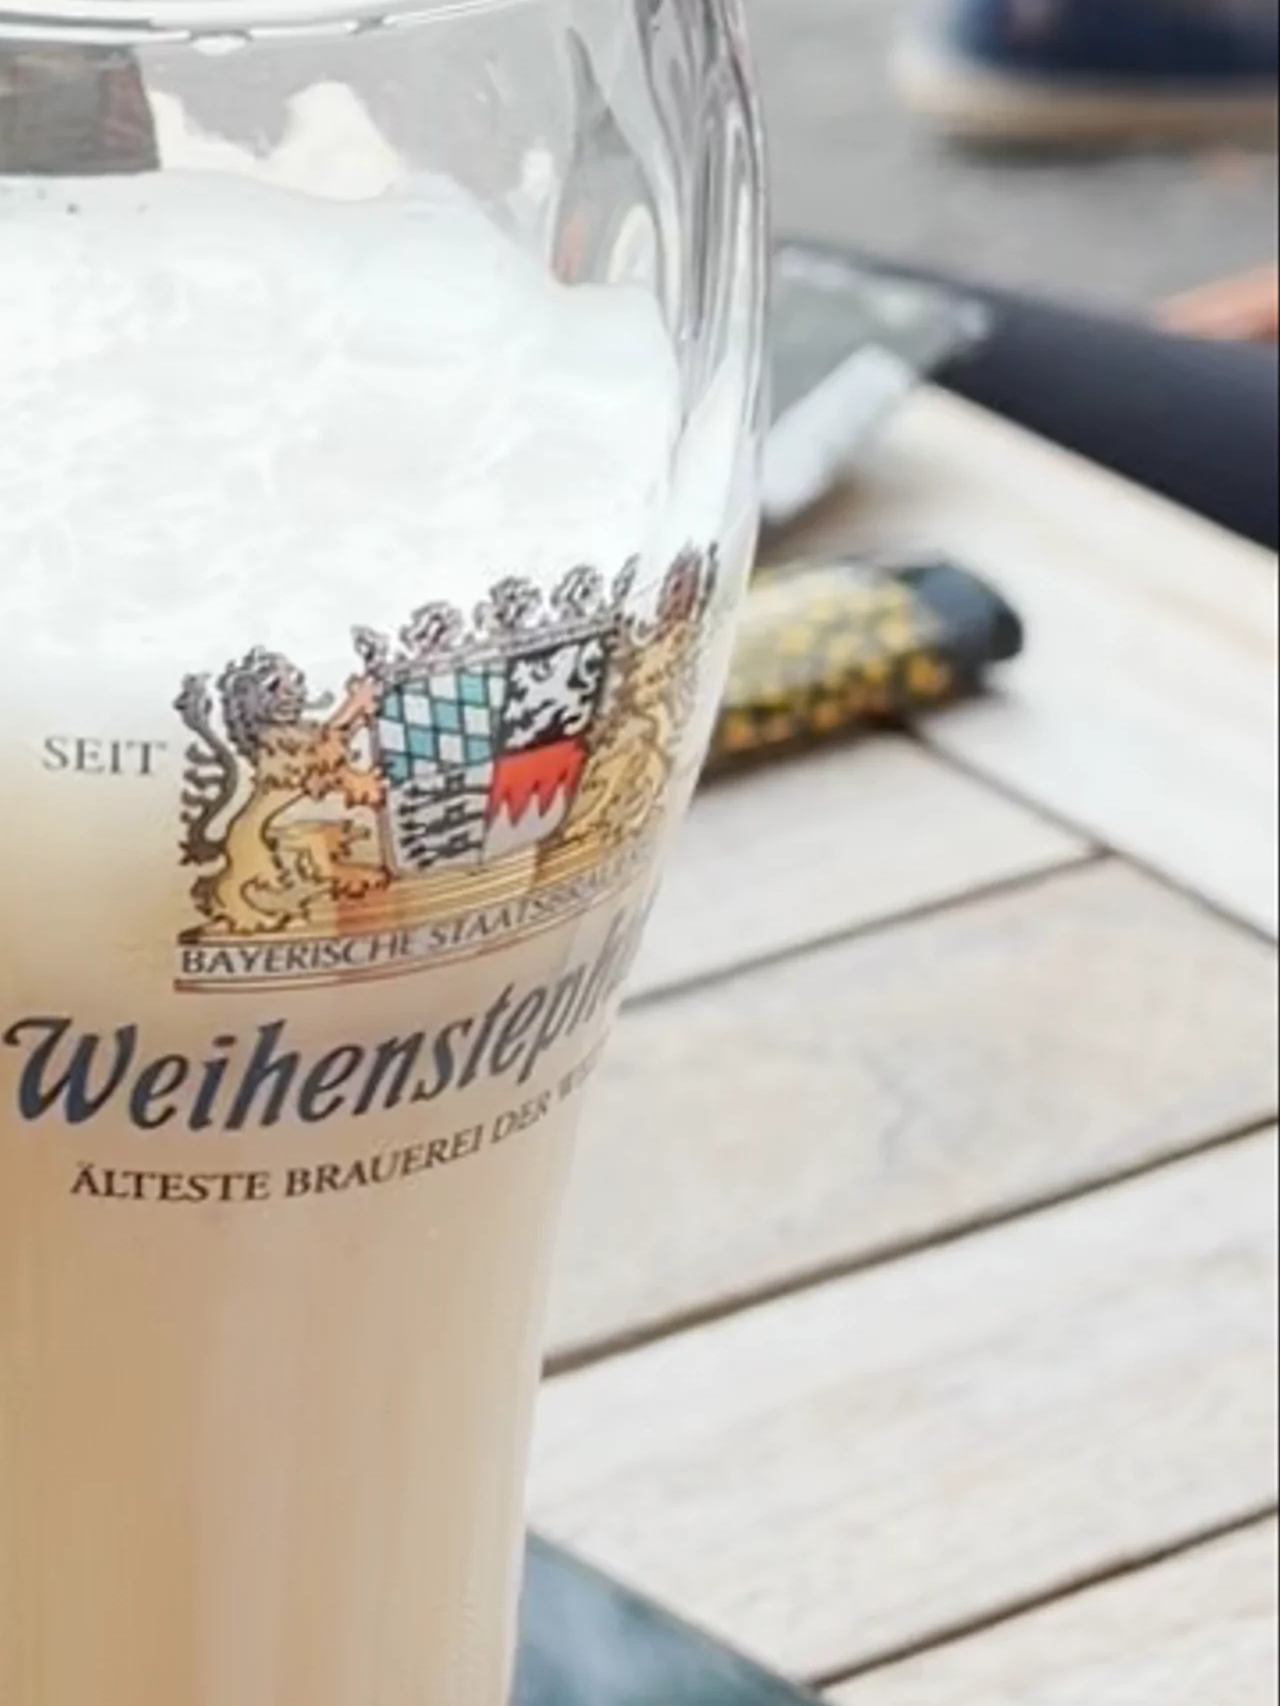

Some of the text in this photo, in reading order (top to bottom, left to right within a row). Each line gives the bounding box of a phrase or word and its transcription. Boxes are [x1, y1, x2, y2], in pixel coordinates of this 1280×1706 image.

[41, 735, 168, 776] SEIT
[180, 932, 415, 975] BAYERISCHE
[1, 888, 652, 1133] Weihensteph
[70, 1090, 553, 1204] ÄLTESTE BRAUEREI DER
